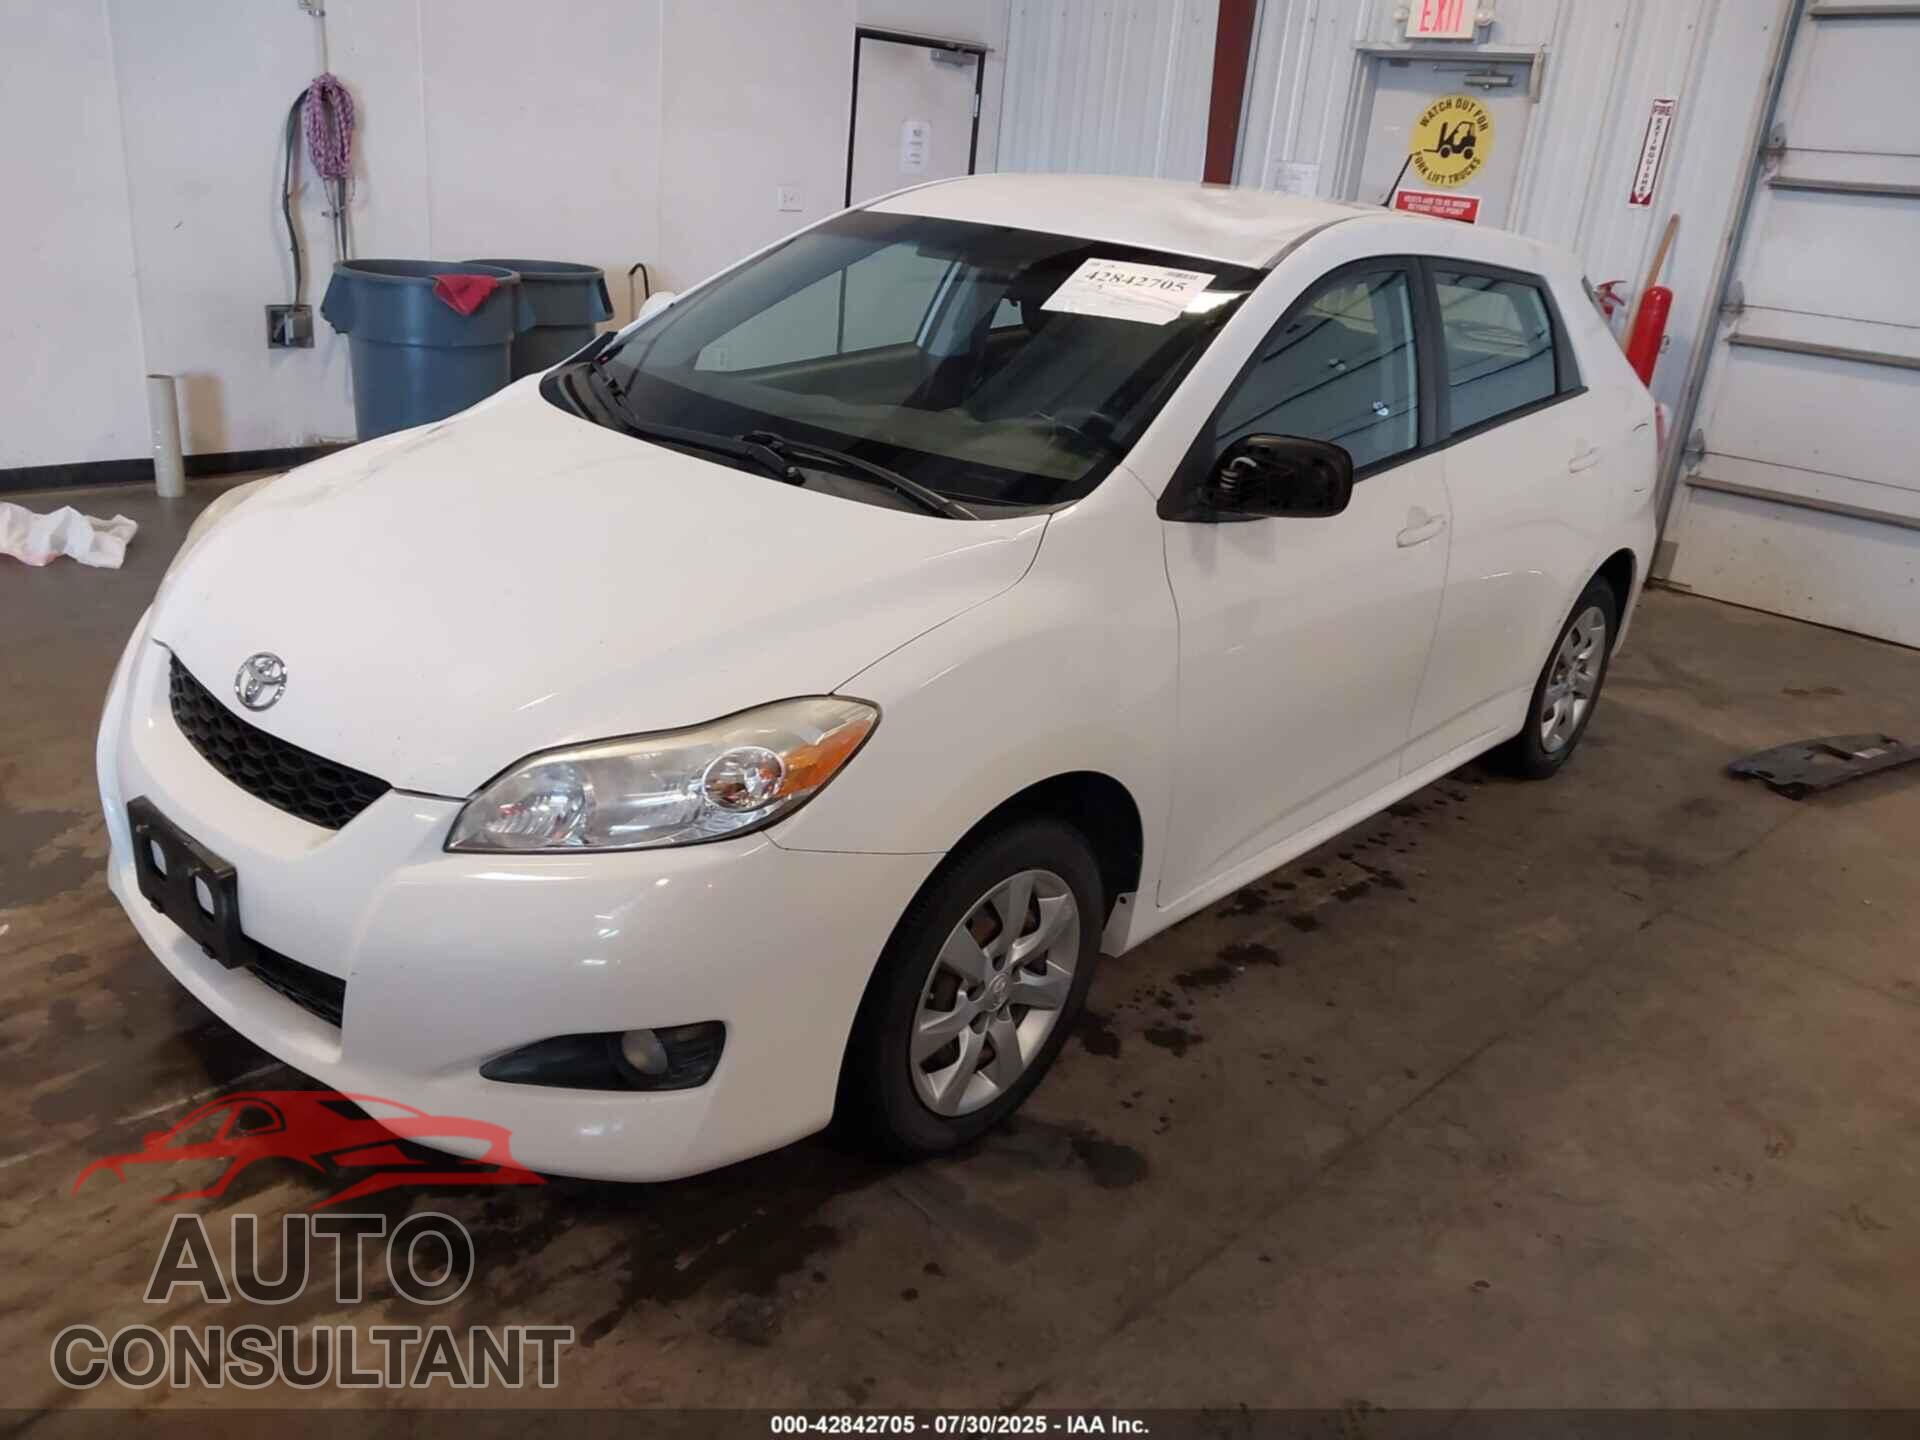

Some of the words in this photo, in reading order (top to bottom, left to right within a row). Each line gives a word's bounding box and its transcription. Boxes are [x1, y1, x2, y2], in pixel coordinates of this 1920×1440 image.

[1418, 0, 1465, 33] EXIT
[1419, 99, 1453, 128] WATCH
[1455, 98, 1476, 113] OUT
[1473, 109, 1489, 132] FOR
[1653, 105, 1673, 117] FIRE
[1427, 170, 1446, 185] LIFT
[1447, 156, 1481, 185] TRUCKS
[1085, 270, 1188, 293] 42842705
